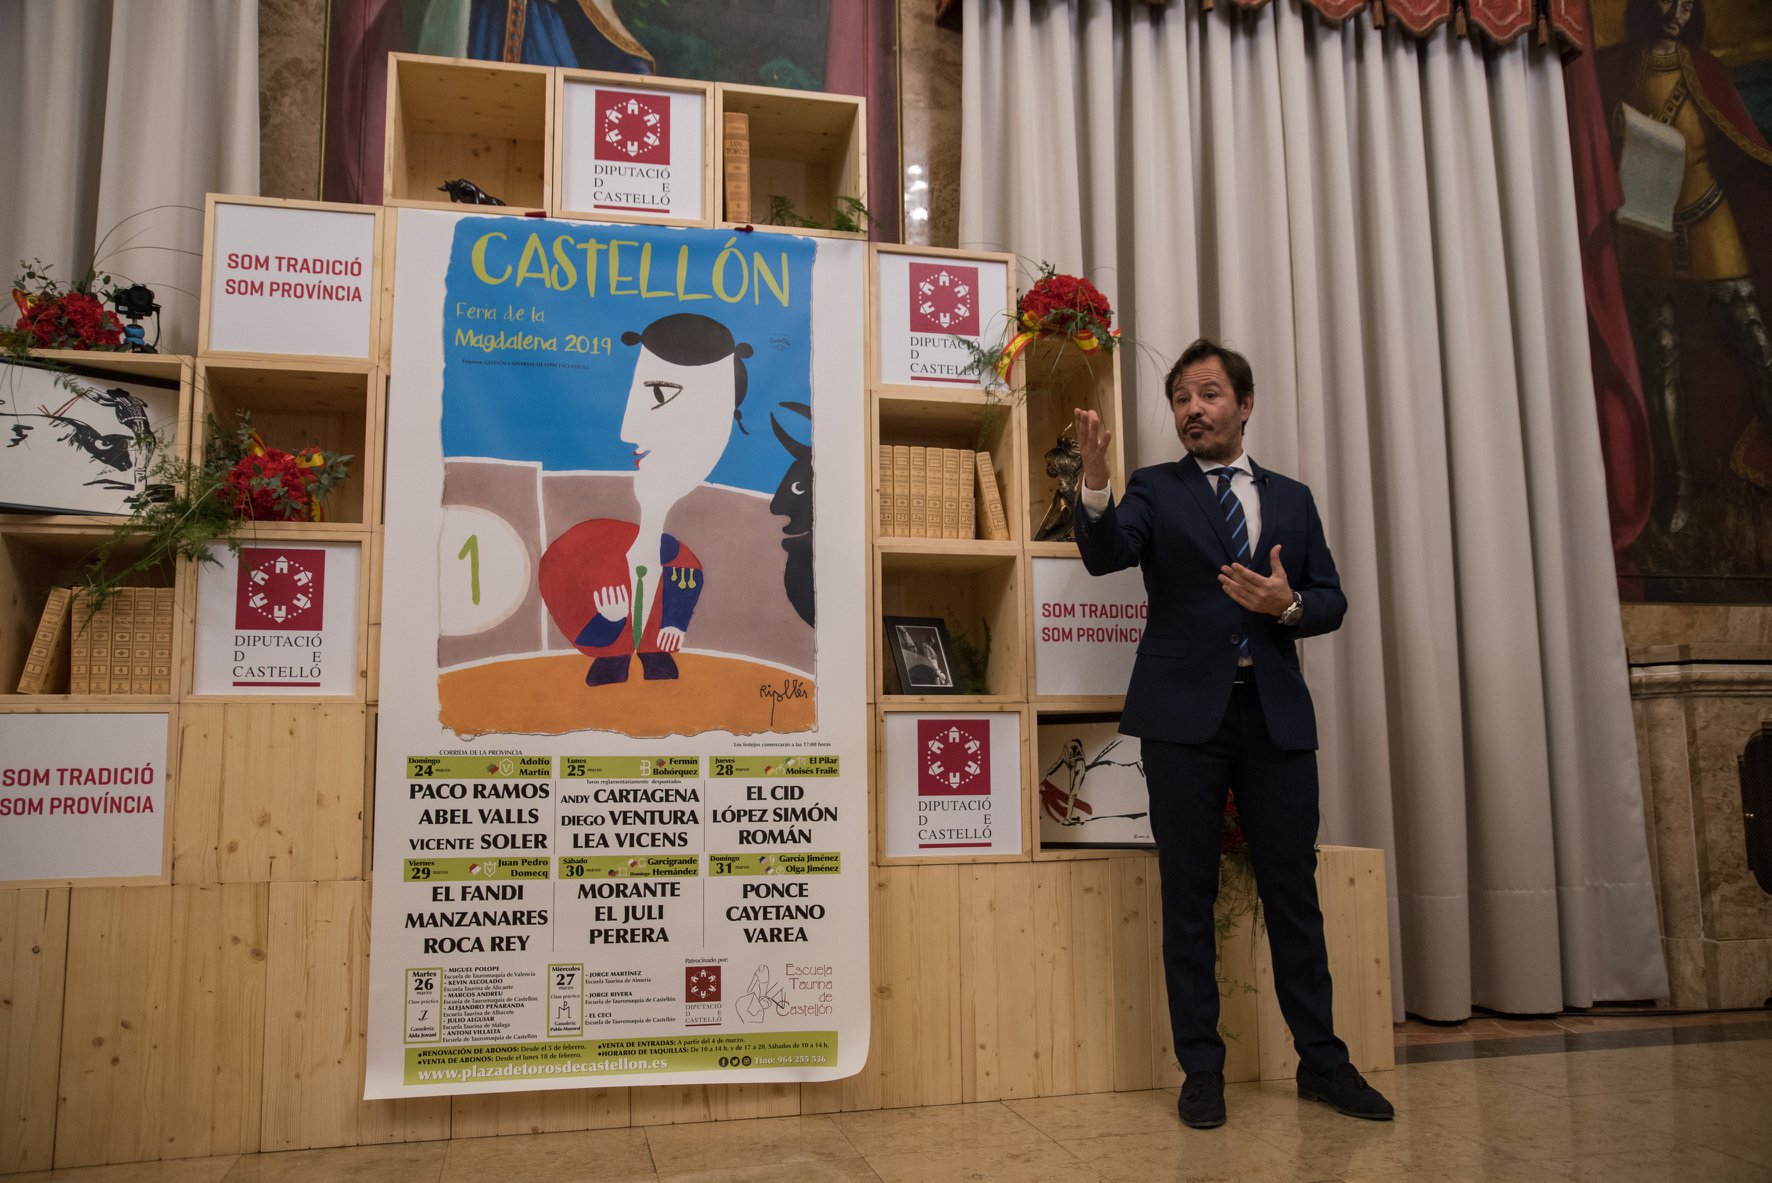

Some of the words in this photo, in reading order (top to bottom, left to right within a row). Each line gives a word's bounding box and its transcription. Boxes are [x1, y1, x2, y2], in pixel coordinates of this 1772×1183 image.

[594, 164, 670, 180] DIPUTACIÓ
[594, 178, 604, 188] D
[593, 191, 670, 205] CASTELLÓ
[227, 253, 269, 271] SOM
[275, 257, 362, 276] TRADICIÓ
[471, 232, 790, 308] CASTELLÓN
[225, 279, 264, 296] SOM
[270, 281, 362, 302] PROVÍNCIA
[456, 302, 496, 320] Feria
[504, 305, 525, 321] de
[531, 306, 545, 322] la
[455, 328, 557, 352] Magdalena
[565, 335, 611, 356] 2019
[910, 350, 919, 359] D
[458, 534, 480, 606] 1
[1042, 603, 1075, 618] SOM
[1079, 601, 1148, 619] TRADICIÓ
[235, 633, 322, 647] DIPUTACIÓ
[1042, 627, 1072, 642] SOM
[1077, 624, 1143, 643] PROVÍNCI
[234, 650, 245, 661] D
[233, 664, 321, 678] CASTELLÓ
[2, 768, 50, 787] SOM
[57, 762, 154, 786] TRADICIÓ
[415, 765, 433, 776] 24
[519, 768, 550, 776] Martín
[567, 765, 585, 776] 25
[653, 768, 697, 777] Bohórquez
[716, 765, 734, 775] 28
[410, 784, 467, 799] PACO
[473, 783, 550, 799] RAMOS
[561, 795, 590, 803] ANDY
[594, 789, 700, 803] CARTAGENA
[747, 786, 767, 800] EL
[771, 786, 804, 800] CID
[0, 798, 44, 816] SOM
[50, 792, 154, 815] PROVÍNCIA
[919, 797, 991, 812] DIPUTACIÓ
[418, 809, 473, 824] ABEL
[478, 809, 539, 824] VALLS
[561, 815, 605, 826] DIEGO
[609, 810, 699, 825] VENTURA
[712, 805, 768, 823] LÓPEZ
[773, 803, 837, 822] SIMÓN
[919, 815, 927, 826] D
[573, 833, 610, 848] LEA
[615, 832, 688, 848] VICENS
[739, 825, 811, 844] ROMÁN
[918, 826, 991, 840] CASTELLÓ
[409, 838, 474, 850] VICENTE
[481, 834, 548, 849] SOLER
[498, 859, 518, 867] Juan
[647, 858, 697, 867] Garcigrande
[716, 862, 732, 874] 31
[786, 866, 805, 874] Olga
[411, 867, 431, 879] 29
[511, 870, 548, 878] Domecq
[566, 865, 584, 877] 30
[653, 868, 697, 876] Hernández
[432, 886, 455, 902] EL
[461, 885, 523, 901] FANDI
[578, 882, 680, 899] MORANTE
[742, 883, 808, 898] PONCE
[405, 910, 548, 928] MANZANARES
[595, 906, 617, 921] EL
[622, 905, 663, 924] JULI
[726, 904, 825, 922] CAYETANO
[590, 927, 669, 944] PERERA
[743, 927, 808, 943] VAREA
[424, 937, 485, 954] ROCA
[491, 935, 530, 952] REY
[785, 963, 832, 977] Escuela
[414, 978, 433, 991] 26
[556, 974, 575, 985] 27
[789, 978, 832, 990] Taurina
[819, 992, 832, 1002] de
[776, 1001, 832, 1016] Castellón
[474, 1047, 484, 1055] DE
[485, 1046, 519, 1054] ABONOS:
[418, 1057, 668, 1081] www.plazadetorosdecastellon.es
